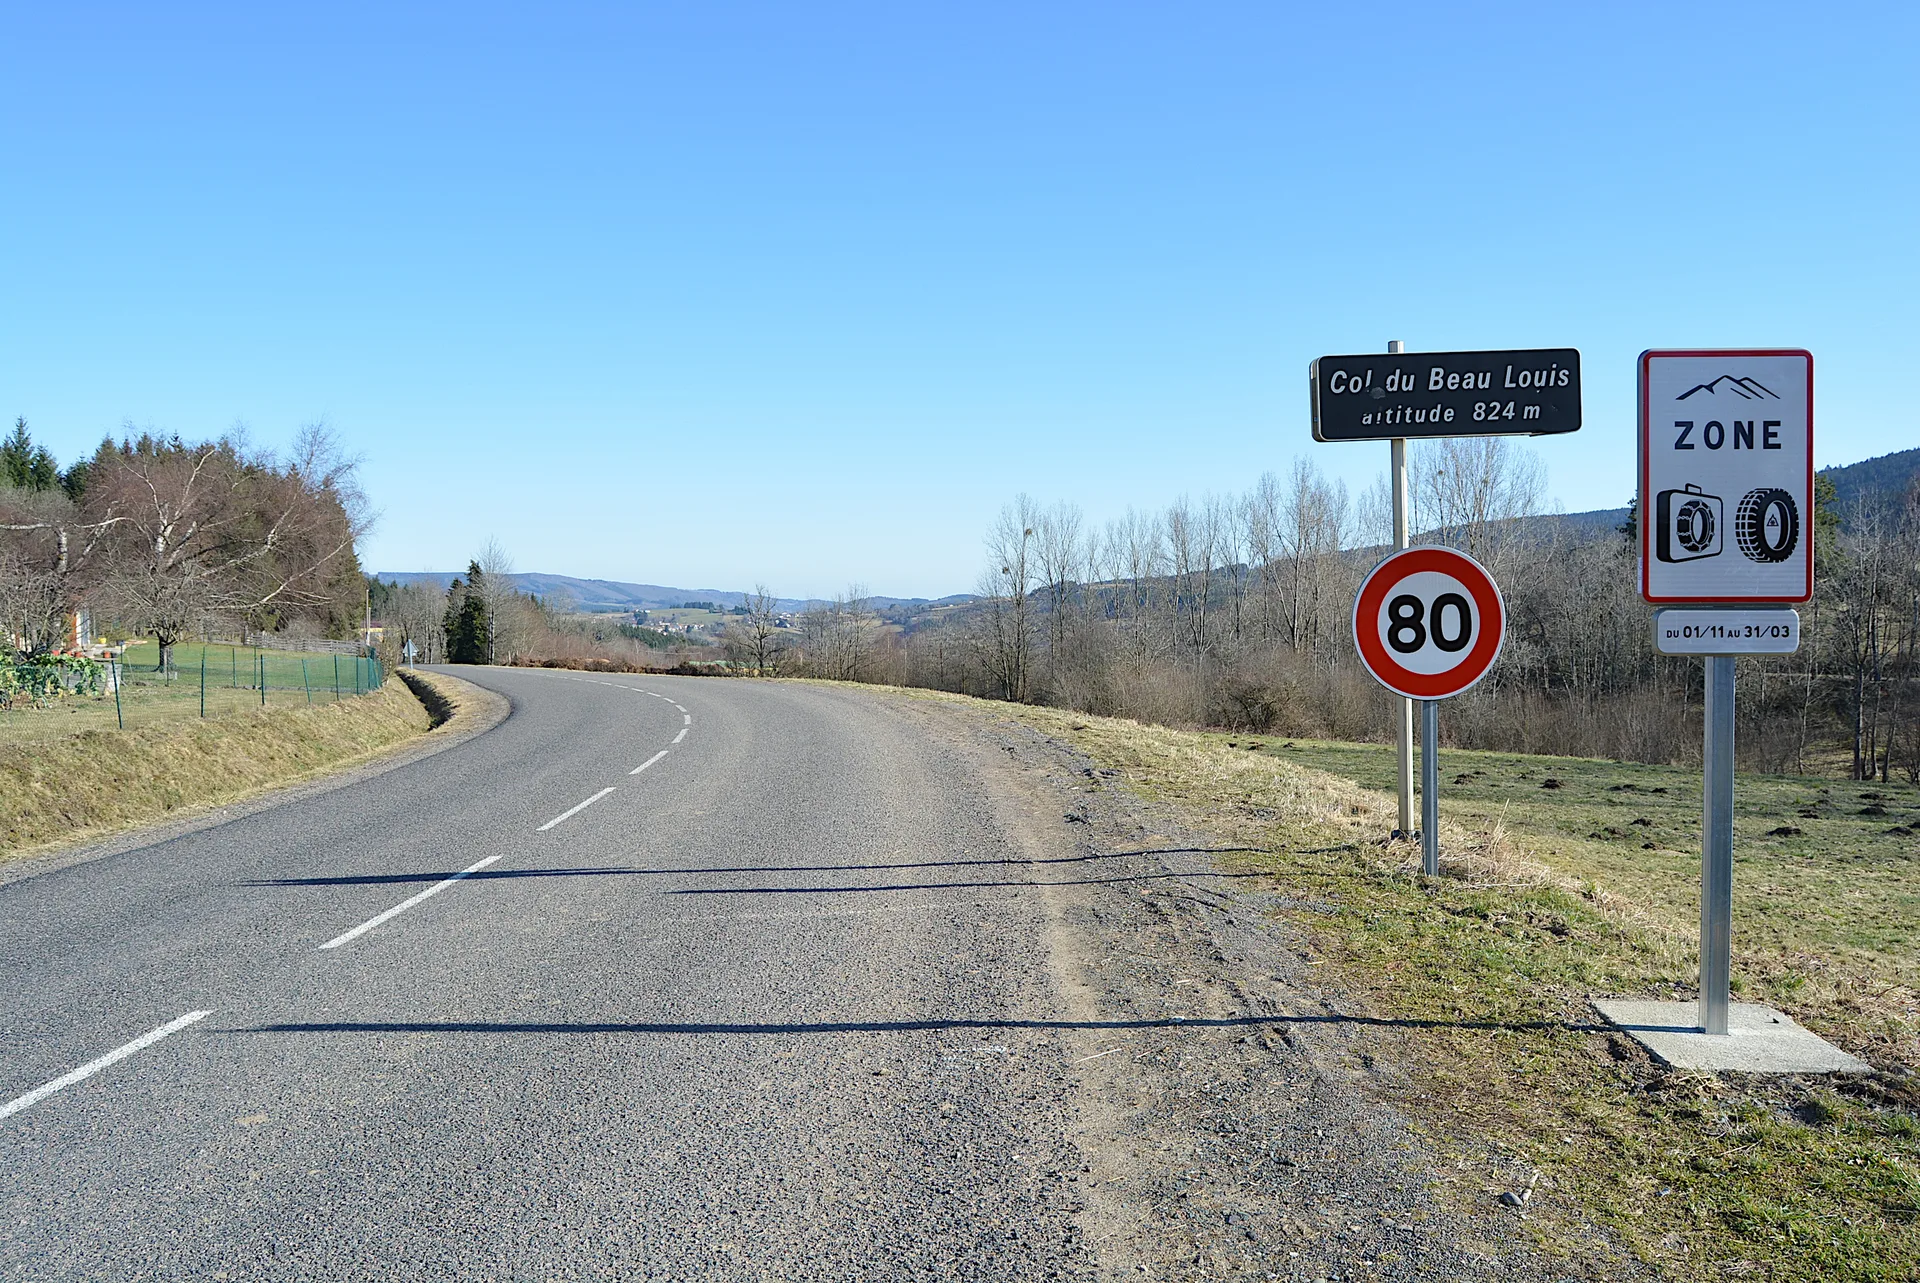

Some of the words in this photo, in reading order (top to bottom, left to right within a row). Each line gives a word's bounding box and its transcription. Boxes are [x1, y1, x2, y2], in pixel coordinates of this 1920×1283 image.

[1330, 369, 1372, 394] Col
[1385, 369, 1415, 392] du
[1428, 367, 1491, 391] Beau
[1504, 364, 1570, 389] Louis
[1472, 401, 1515, 421] 824
[1523, 404, 1541, 420] m
[1674, 420, 1782, 450] ZONE
[1387, 592, 1472, 654] 80
[1666, 629, 1680, 638] DU
[1683, 625, 1724, 638] 01/11
[1727, 629, 1741, 638] AU
[1744, 625, 1790, 638] 31/03
